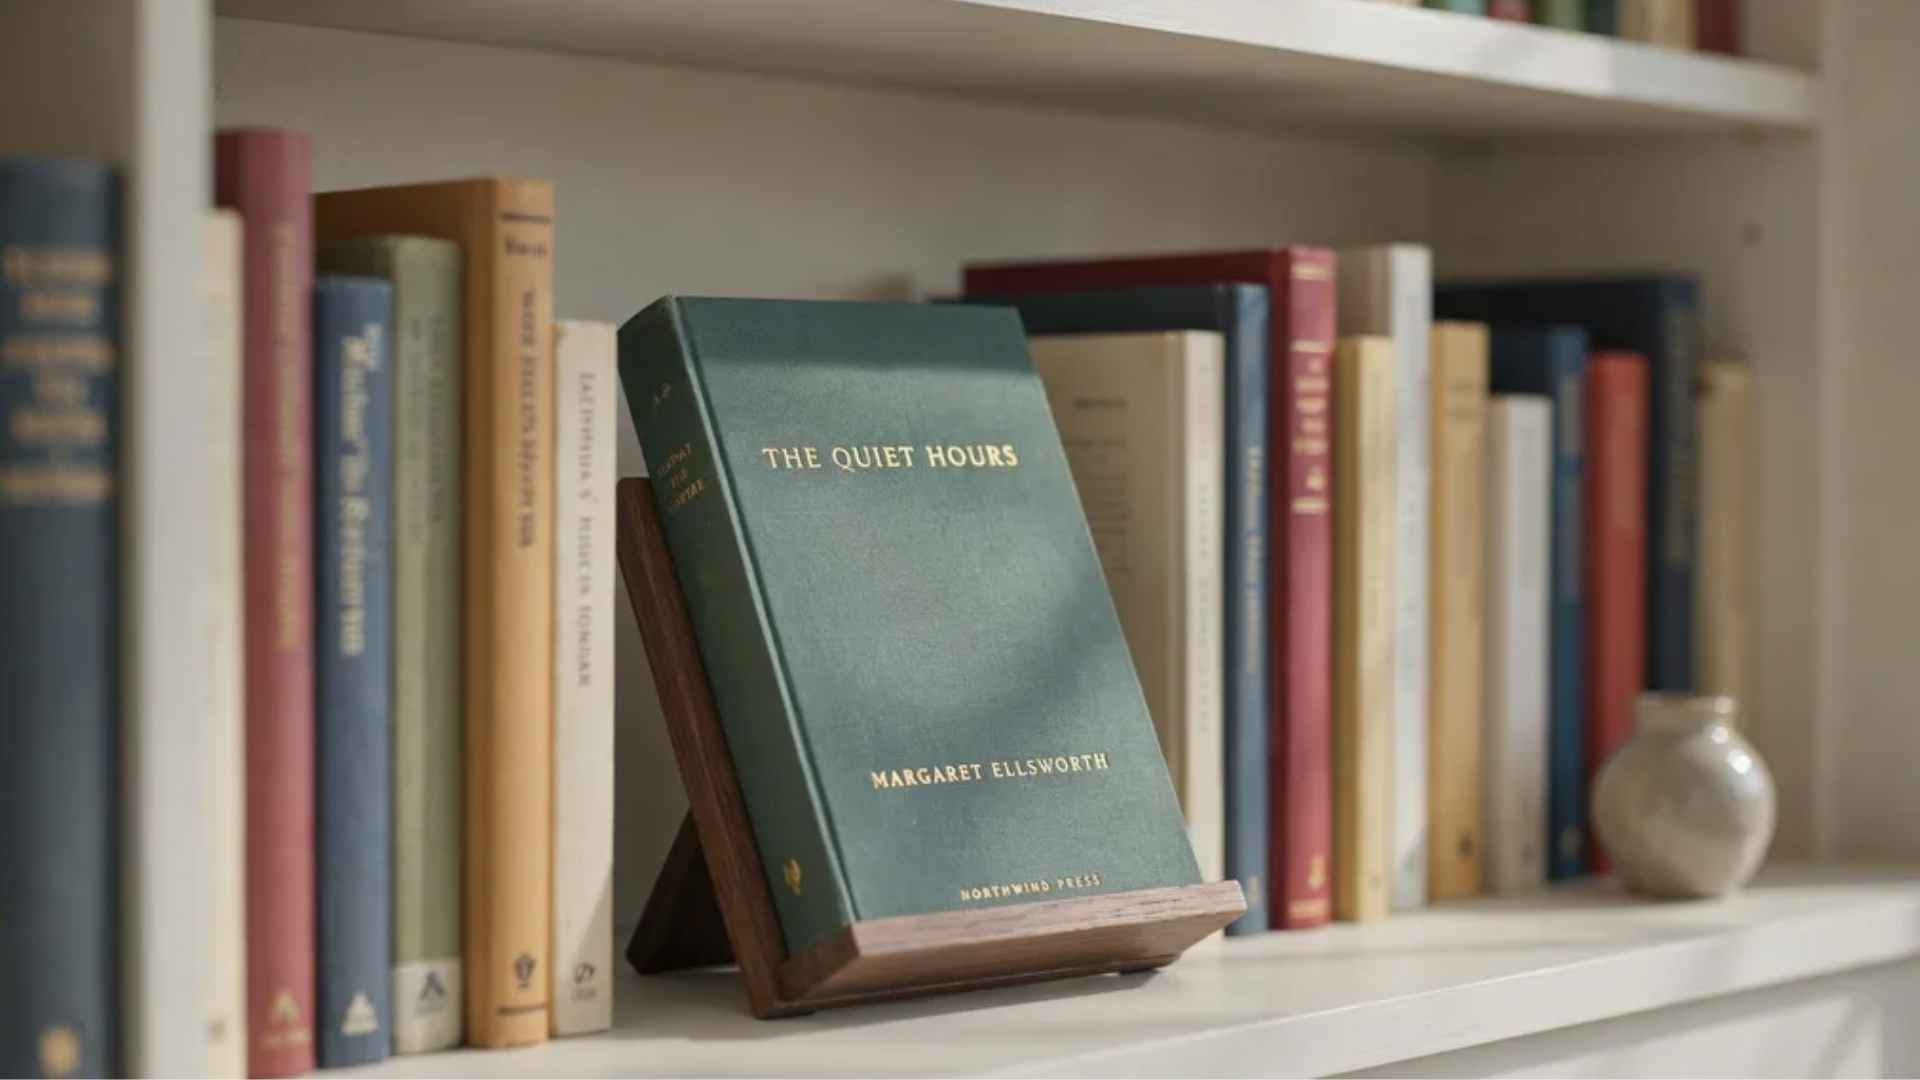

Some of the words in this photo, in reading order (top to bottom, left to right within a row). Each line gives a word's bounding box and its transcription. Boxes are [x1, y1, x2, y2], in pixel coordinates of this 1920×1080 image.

[762, 446, 821, 469] THE
[832, 446, 914, 472] QUIET
[925, 444, 1019, 467] HOURS
[870, 763, 983, 789] MARGARET
[991, 752, 1111, 778] ELLSWORTH
[960, 878, 1050, 901] NORTHWIND
[1056, 873, 1103, 890] PRESS
